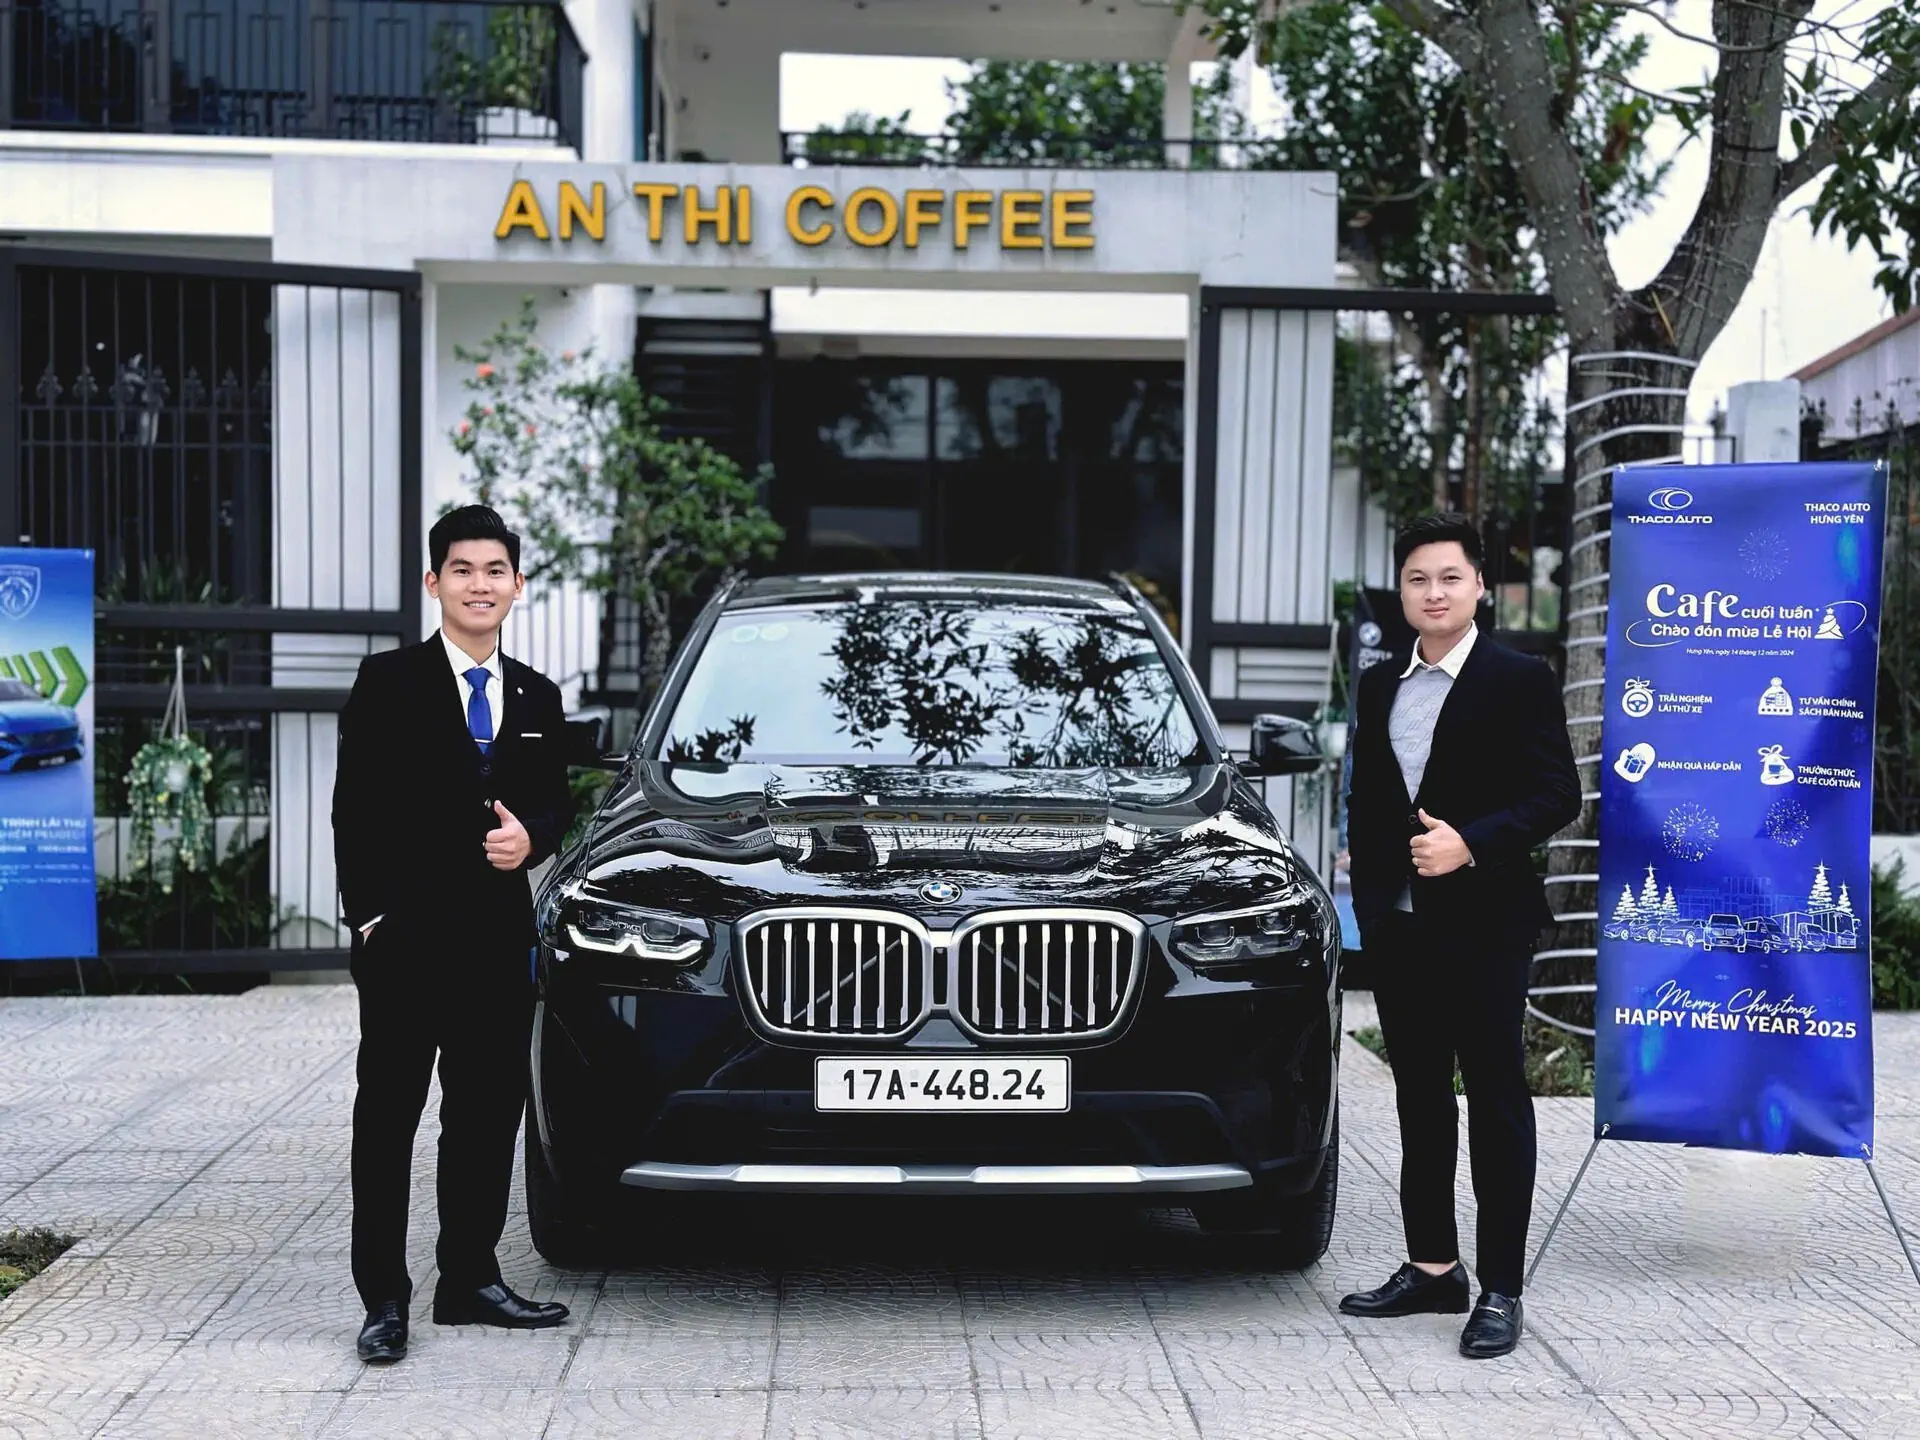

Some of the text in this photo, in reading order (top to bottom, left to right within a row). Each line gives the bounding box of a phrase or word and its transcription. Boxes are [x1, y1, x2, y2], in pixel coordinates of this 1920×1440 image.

[495, 180, 1095, 250] AN THI COFFEE
[1804, 503, 1871, 512] THACO AUTO
[1628, 515, 1713, 524] THACO AUTO
[1810, 514, 1864, 524] HƯNG YÊN
[1646, 583, 1813, 624] Cafe cuối tuần
[1651, 623, 1690, 637] Chào
[1694, 624, 1722, 638] đón
[1726, 625, 1760, 638] mùa
[1787, 626, 1811, 641] Hội
[1679, 694, 1713, 704] NGHIỆM
[1831, 698, 1856, 707] CHÍNH
[1691, 705, 1703, 713] XE
[1799, 707, 1864, 719] SÁCH BÁN HÀNG
[1655, 979, 1817, 1019] Merry Christmas
[1615, 1007, 1857, 1039] HAPPY NEW YEAR 2025
[843, 1068, 1046, 1101] 17A-448.24
